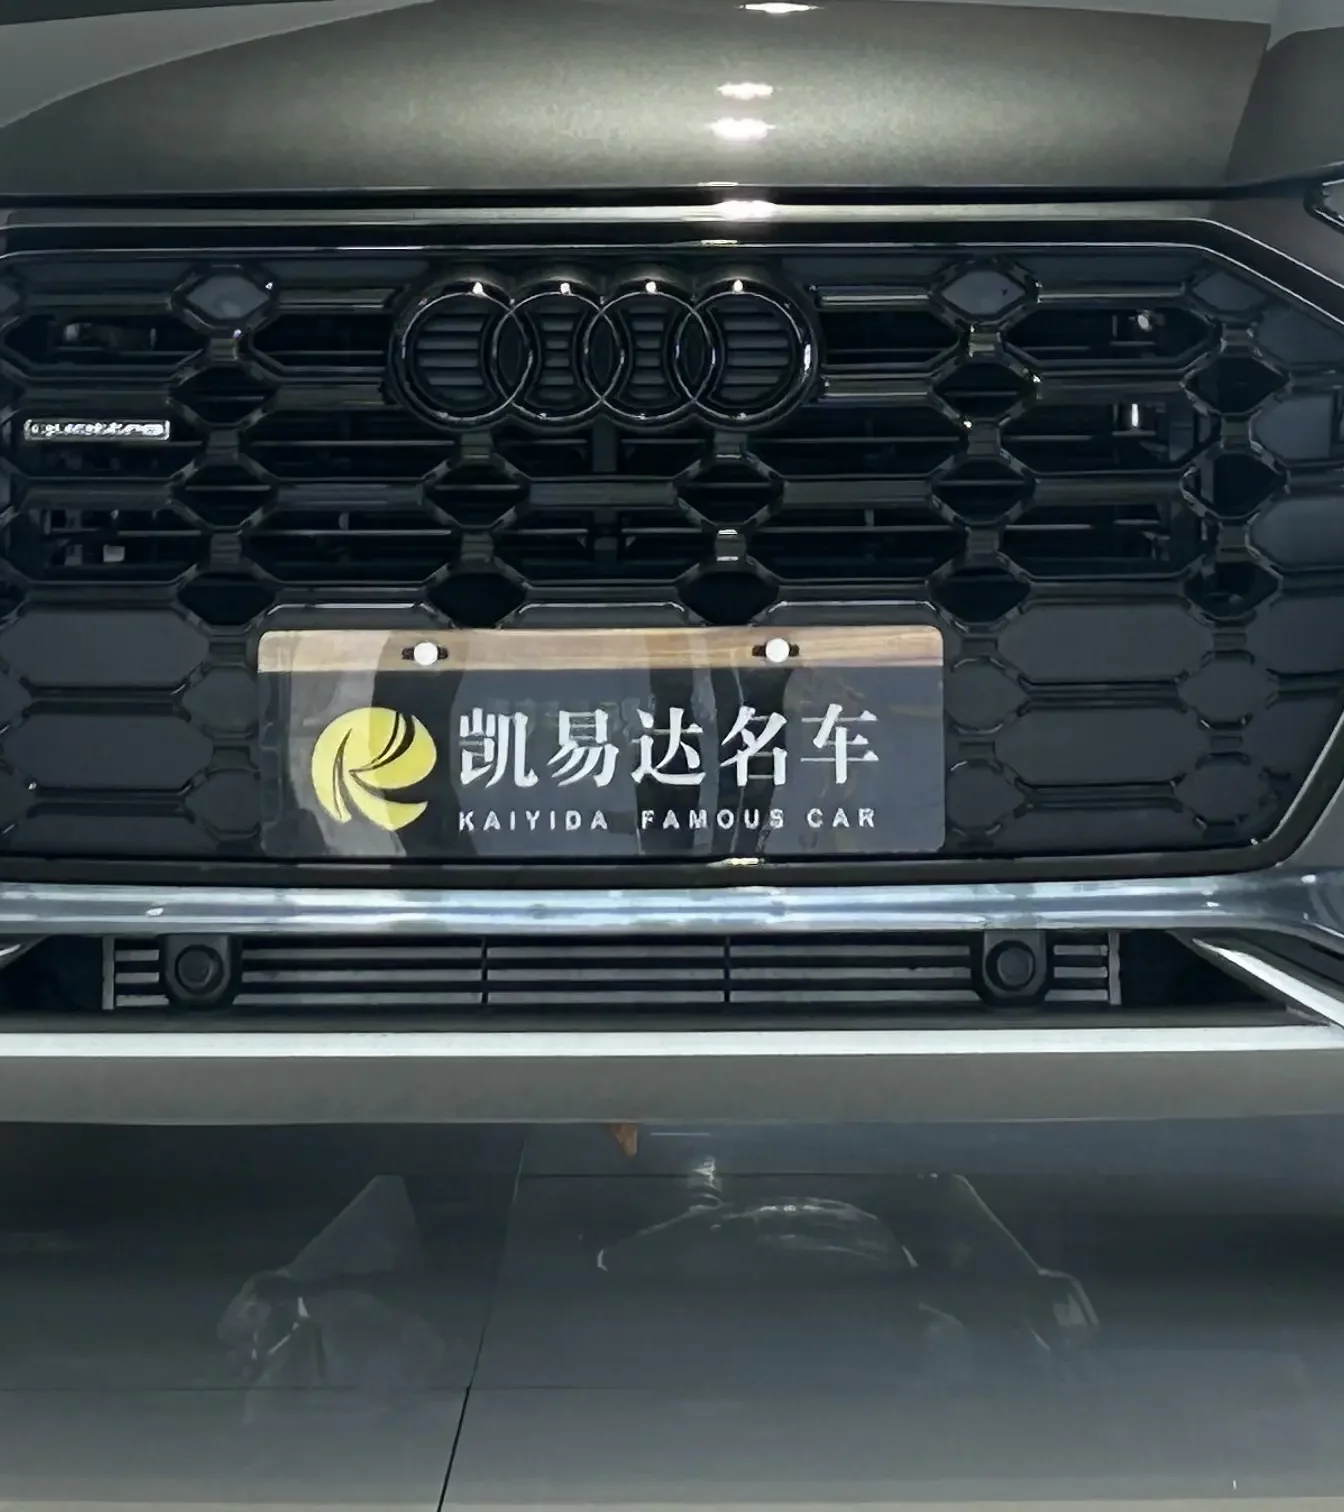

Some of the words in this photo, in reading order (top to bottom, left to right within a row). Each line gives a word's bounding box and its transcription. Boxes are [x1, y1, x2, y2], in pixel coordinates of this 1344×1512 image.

[458, 702, 880, 789] 凯易达名车
[458, 809, 608, 832] KAIYIDA
[641, 808, 785, 830] FAMOUS
[805, 807, 876, 829] CAR
